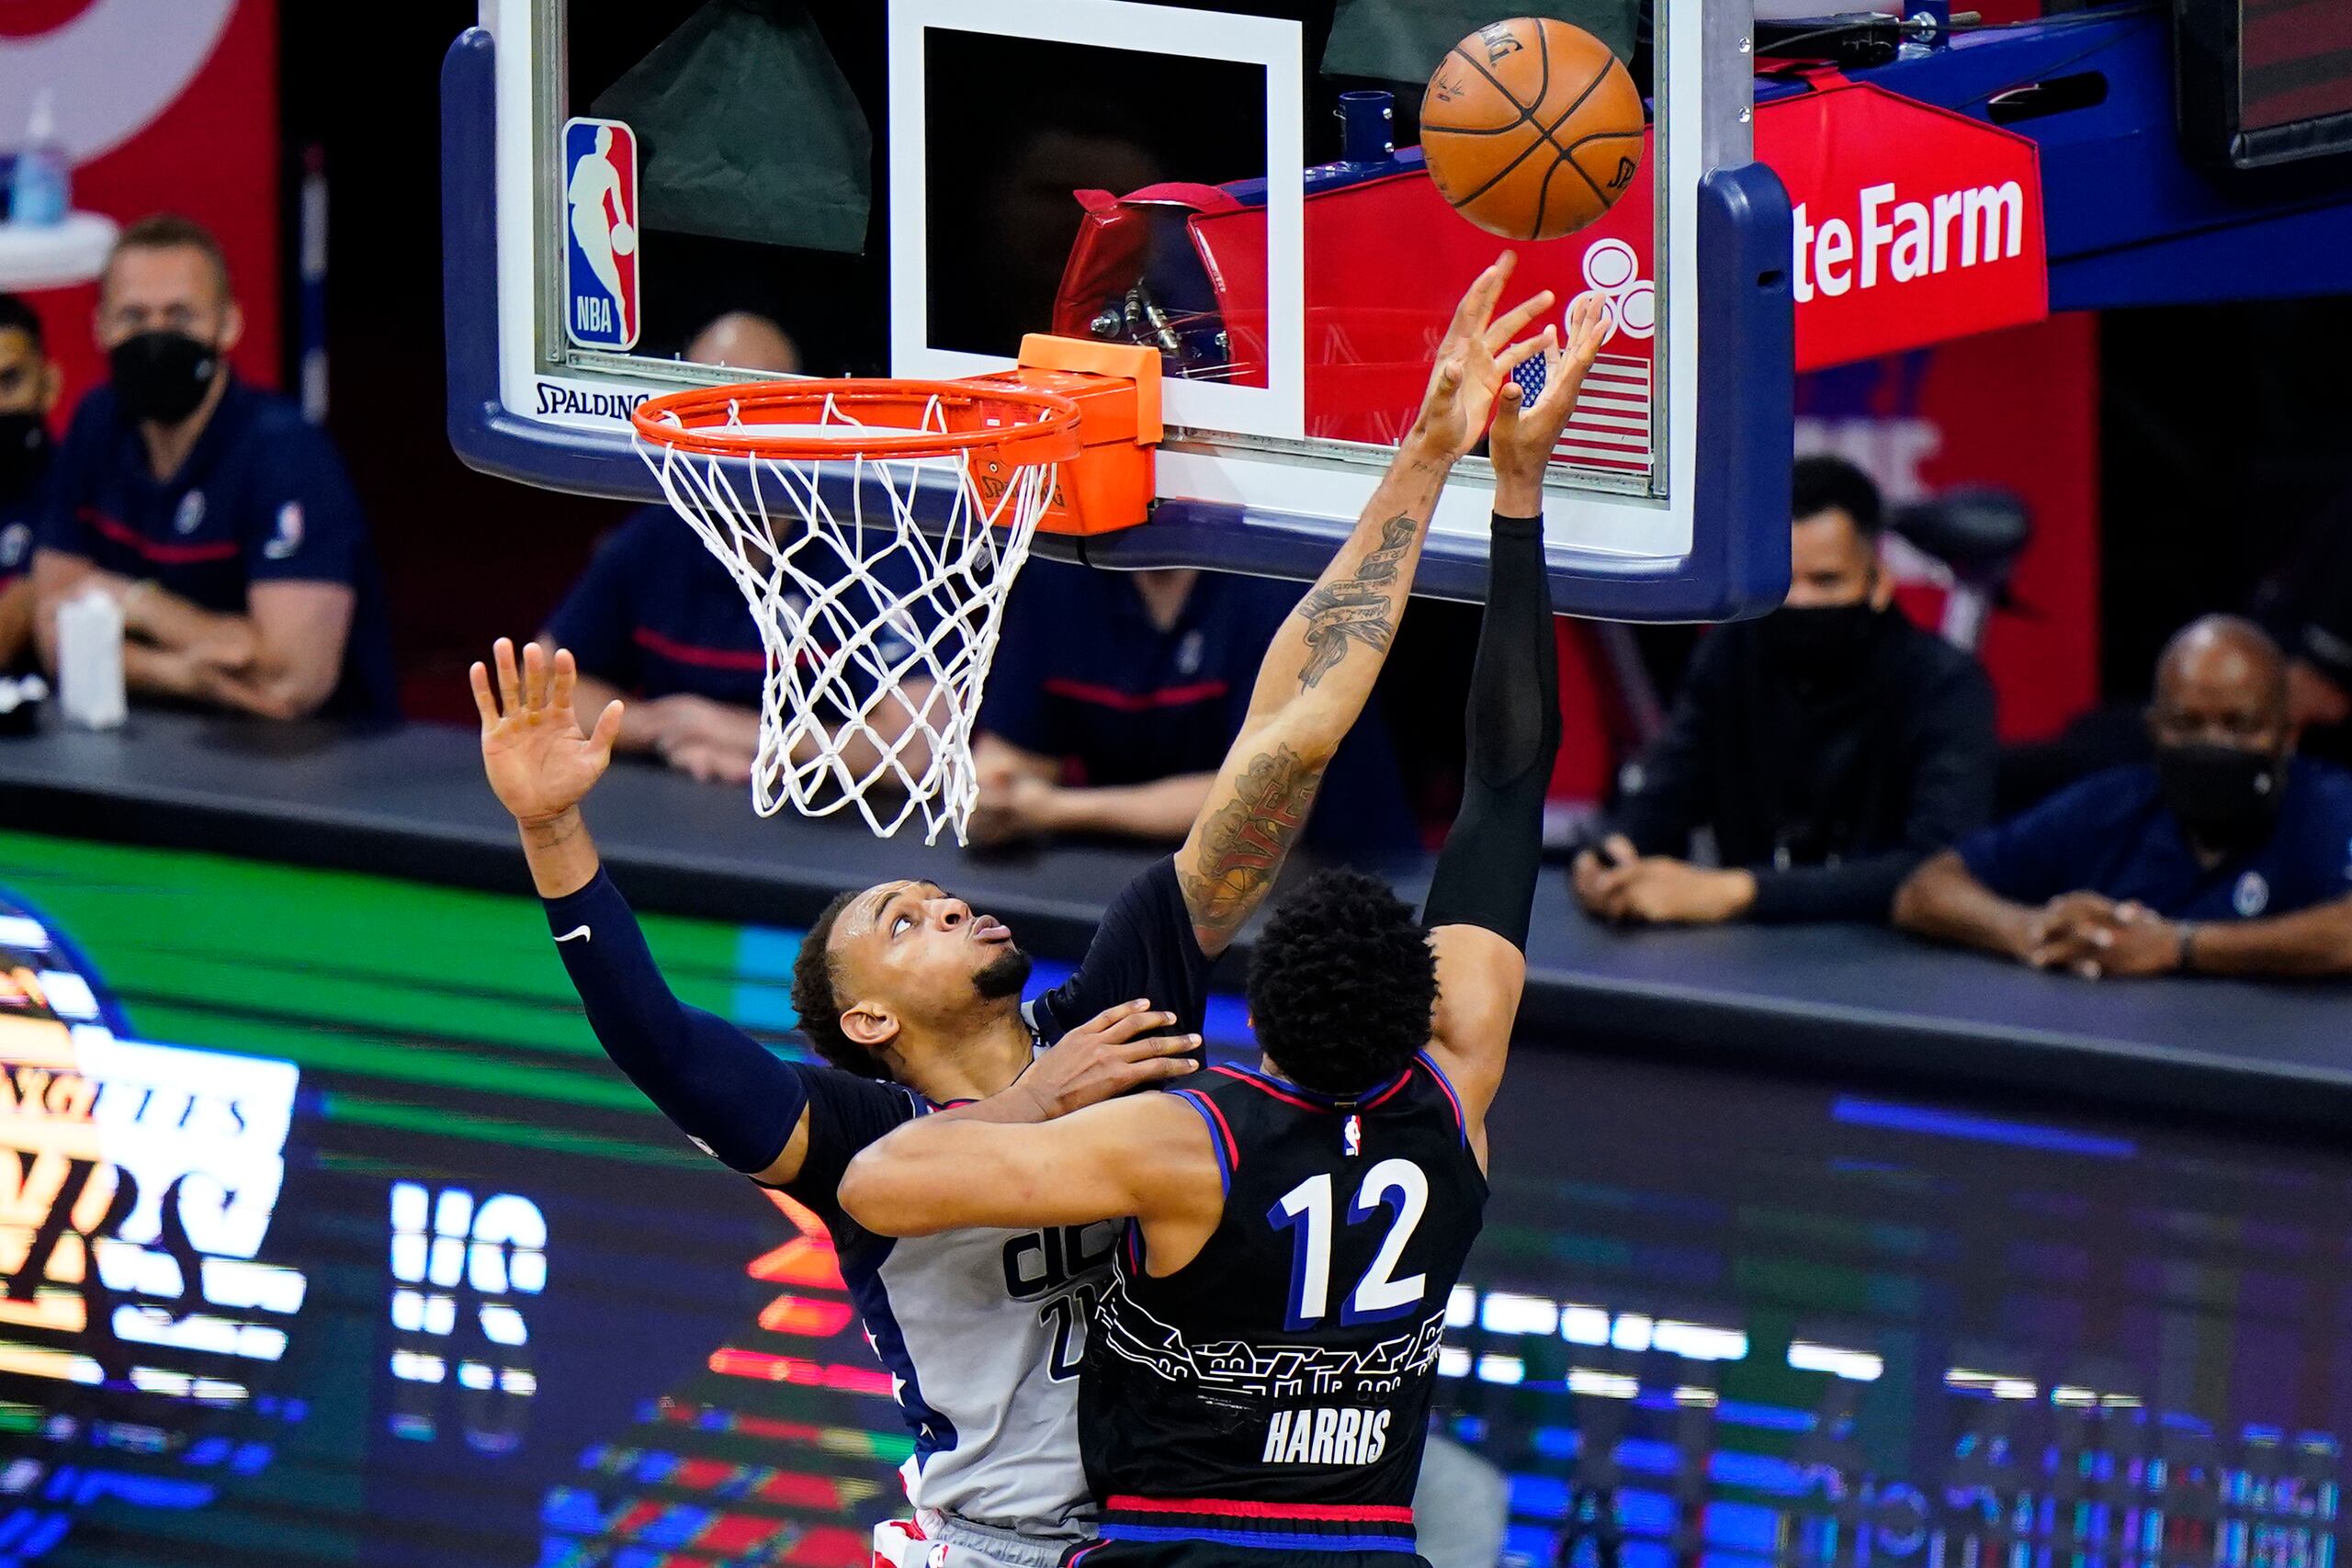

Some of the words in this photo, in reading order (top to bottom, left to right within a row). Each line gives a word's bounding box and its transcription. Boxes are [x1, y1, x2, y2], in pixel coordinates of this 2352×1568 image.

[577, 295, 613, 333] NBA
[1266, 1158, 1429, 1331] 12
[1262, 1408, 1391, 1465] HARRIS
